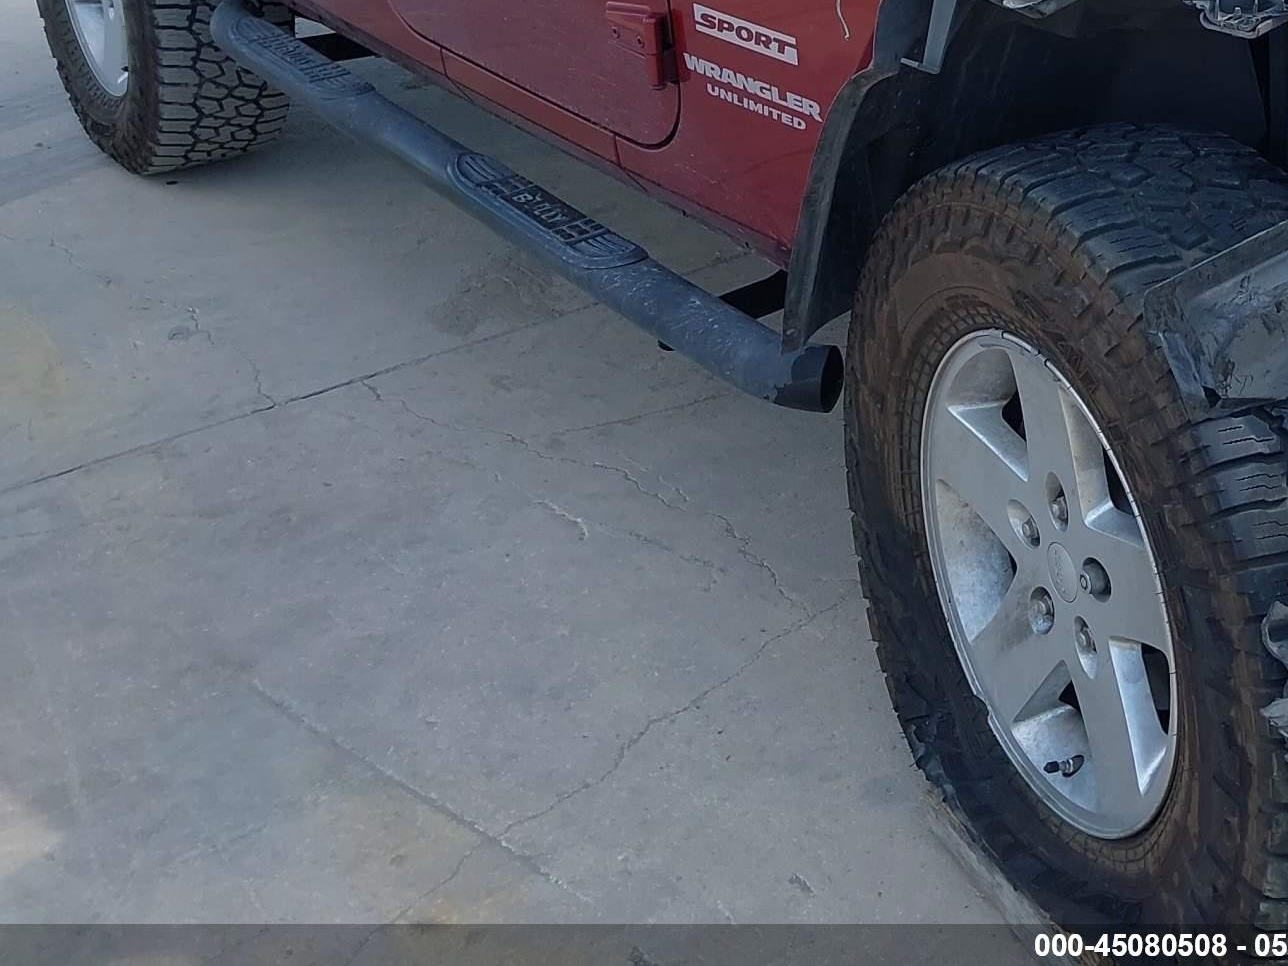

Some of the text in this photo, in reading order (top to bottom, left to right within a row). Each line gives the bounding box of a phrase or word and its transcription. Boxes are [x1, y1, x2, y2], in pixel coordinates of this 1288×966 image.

[697, 9, 798, 57] SPORT
[682, 51, 823, 123] WRANGLER
[706, 82, 808, 131] UNLIMITED
